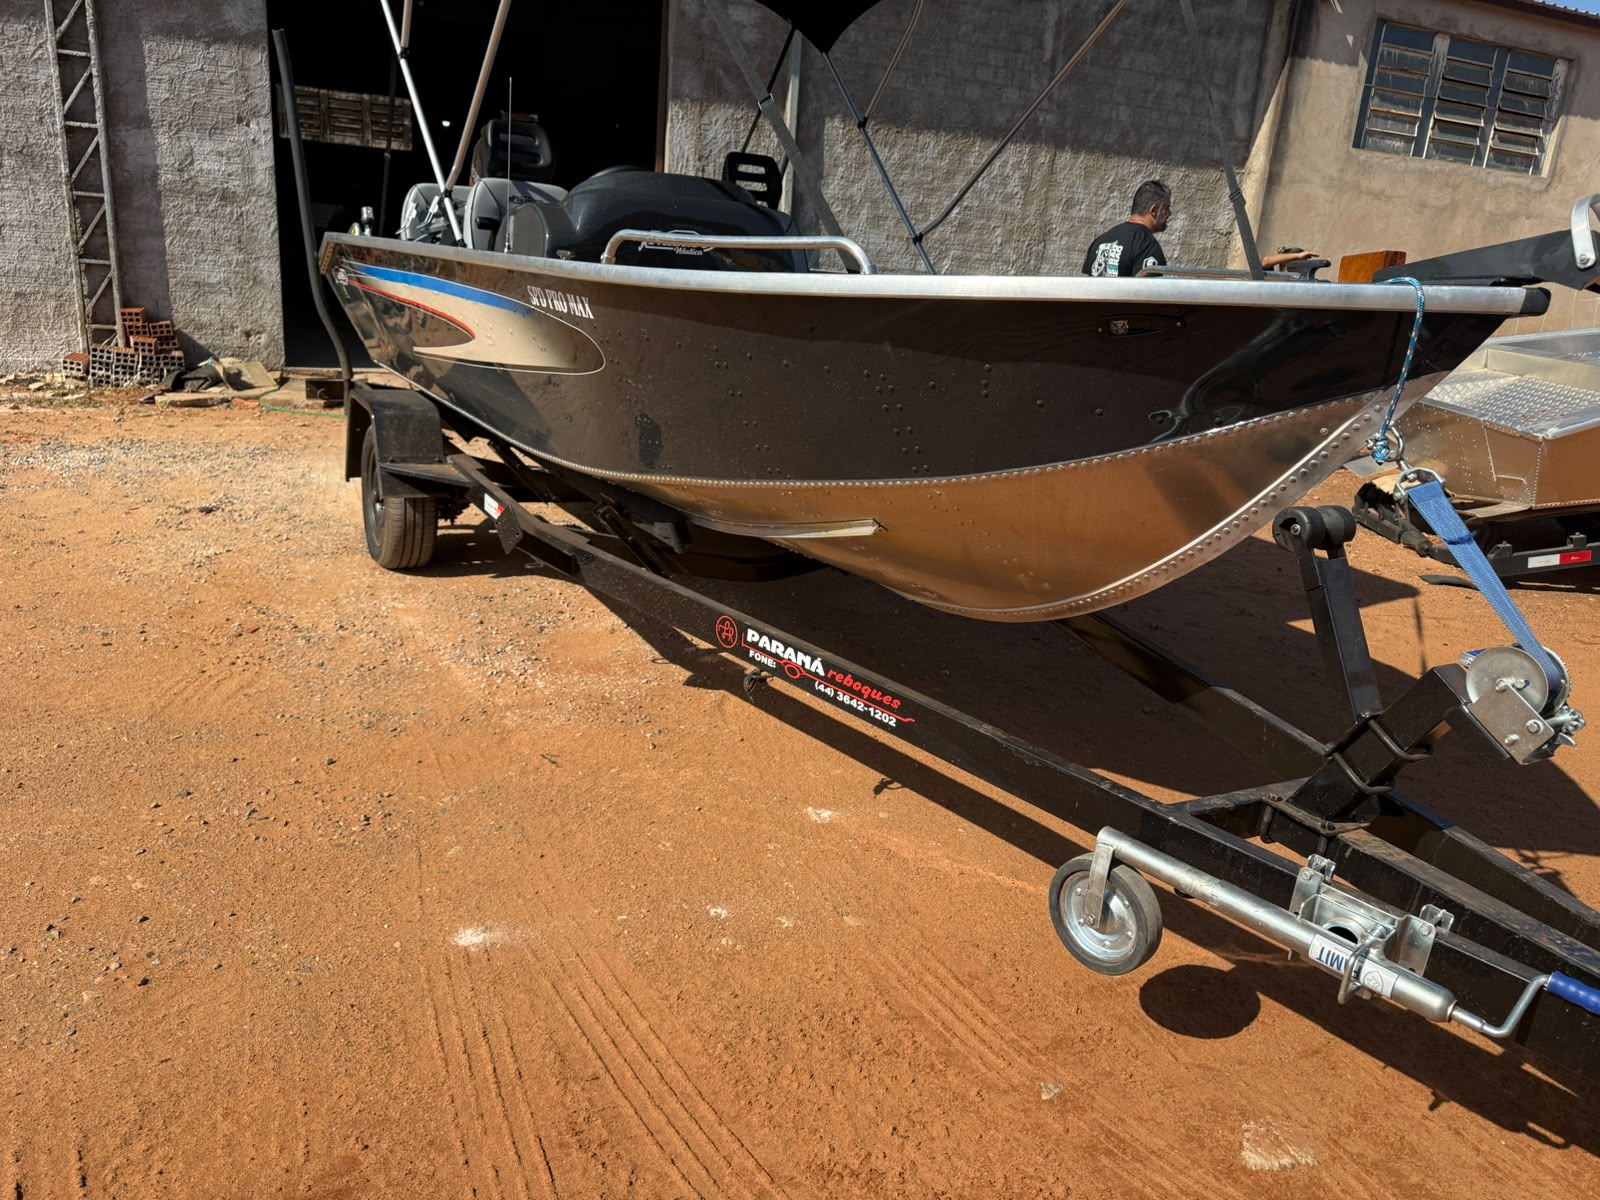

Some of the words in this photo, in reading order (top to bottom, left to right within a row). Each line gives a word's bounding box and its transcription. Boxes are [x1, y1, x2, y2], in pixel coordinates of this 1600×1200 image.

[527, 285, 547, 308] SPD
[545, 289, 568, 314] PRO
[566, 293, 595, 319] MAX
[746, 628, 825, 677] PARANÁ
[827, 669, 901, 710] reboques
[749, 650, 777, 669] FONE:
[814, 680, 835, 698] (44)
[836, 692, 897, 727] 3642-1202
